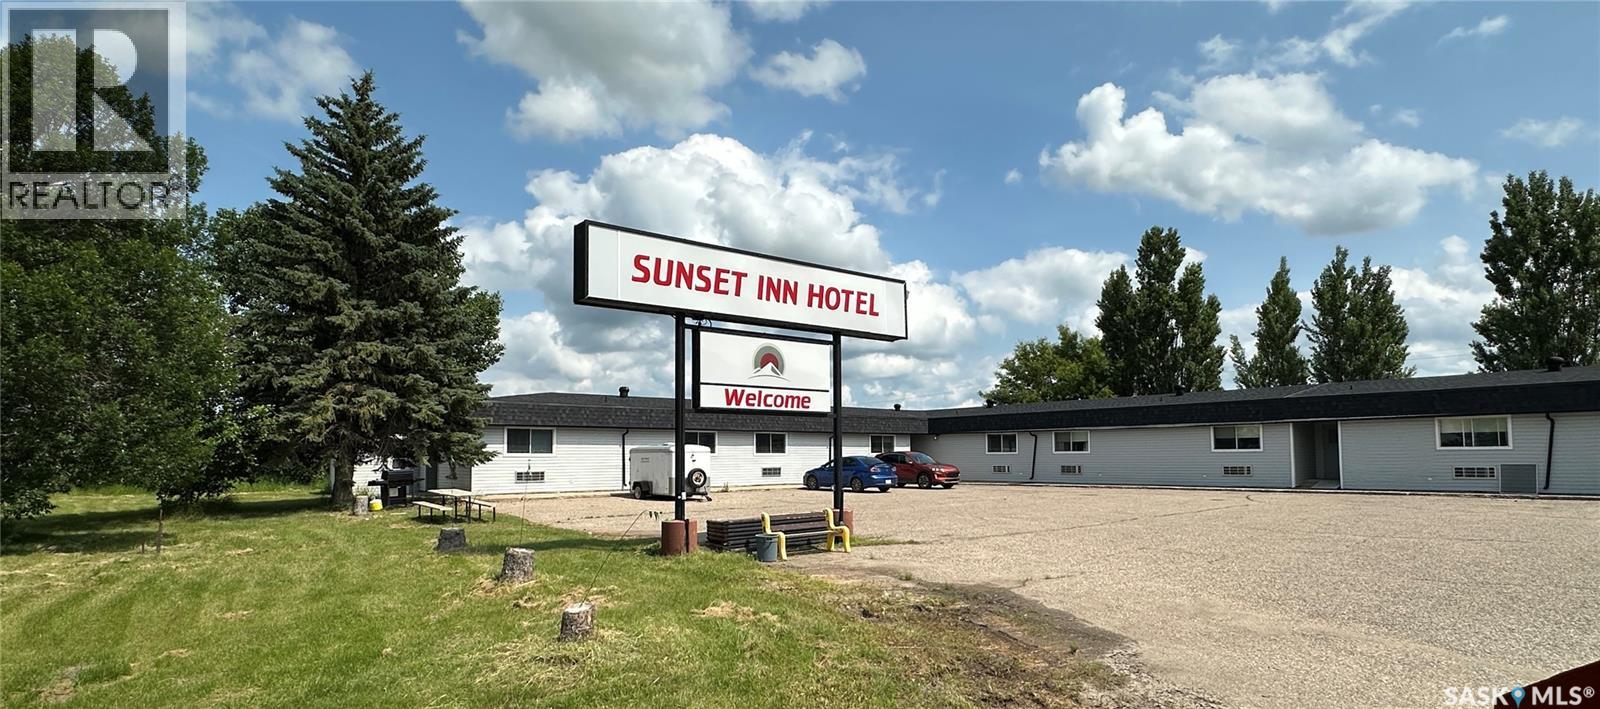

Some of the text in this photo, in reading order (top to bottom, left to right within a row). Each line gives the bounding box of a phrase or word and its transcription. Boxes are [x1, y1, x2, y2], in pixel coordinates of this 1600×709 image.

[631, 254, 880, 317] SUNSET INN HOTEL
[724, 388, 812, 410] Welcome
